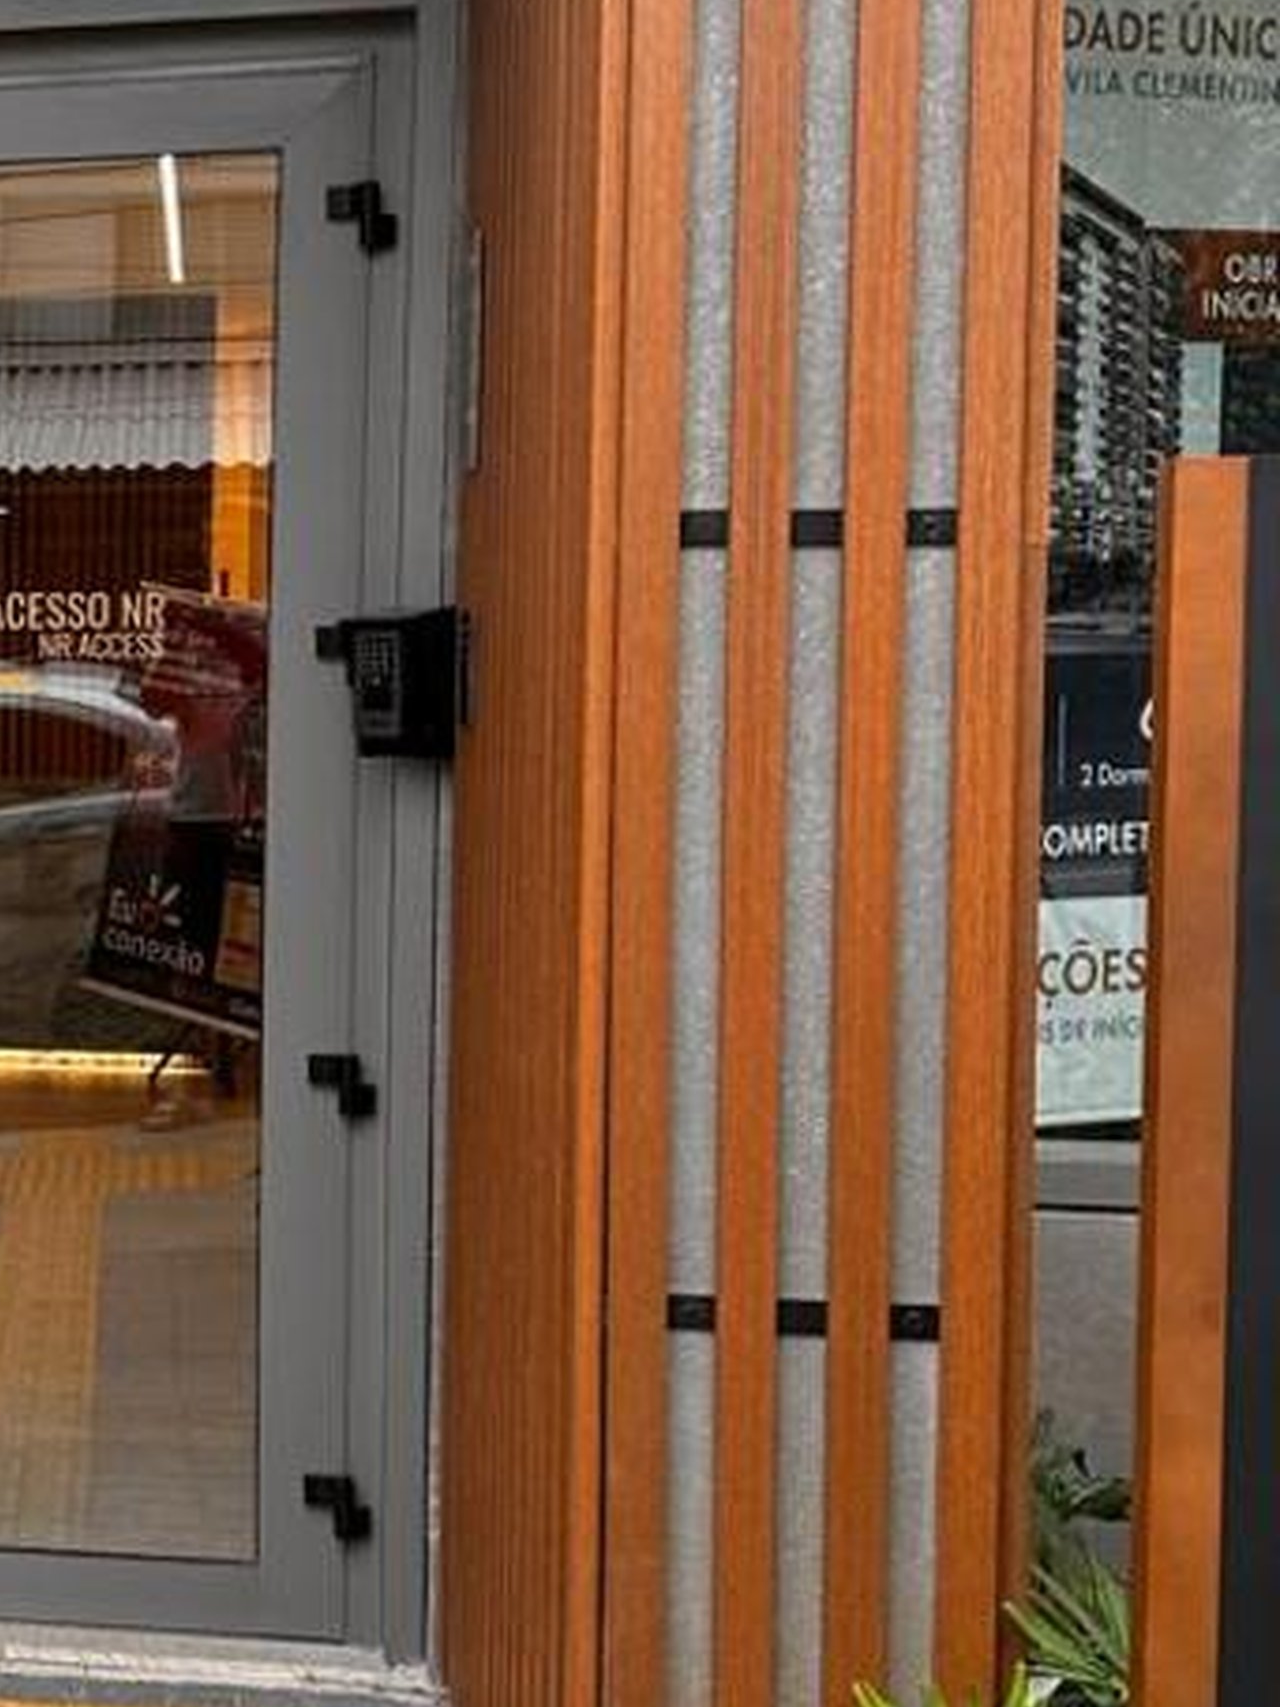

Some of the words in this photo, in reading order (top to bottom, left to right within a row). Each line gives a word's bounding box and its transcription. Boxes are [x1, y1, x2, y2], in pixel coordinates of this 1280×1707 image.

[121, 591, 166, 634] NR
[78, 631, 166, 660] ACCESS
[1040, 819, 1150, 859] OMPLET
